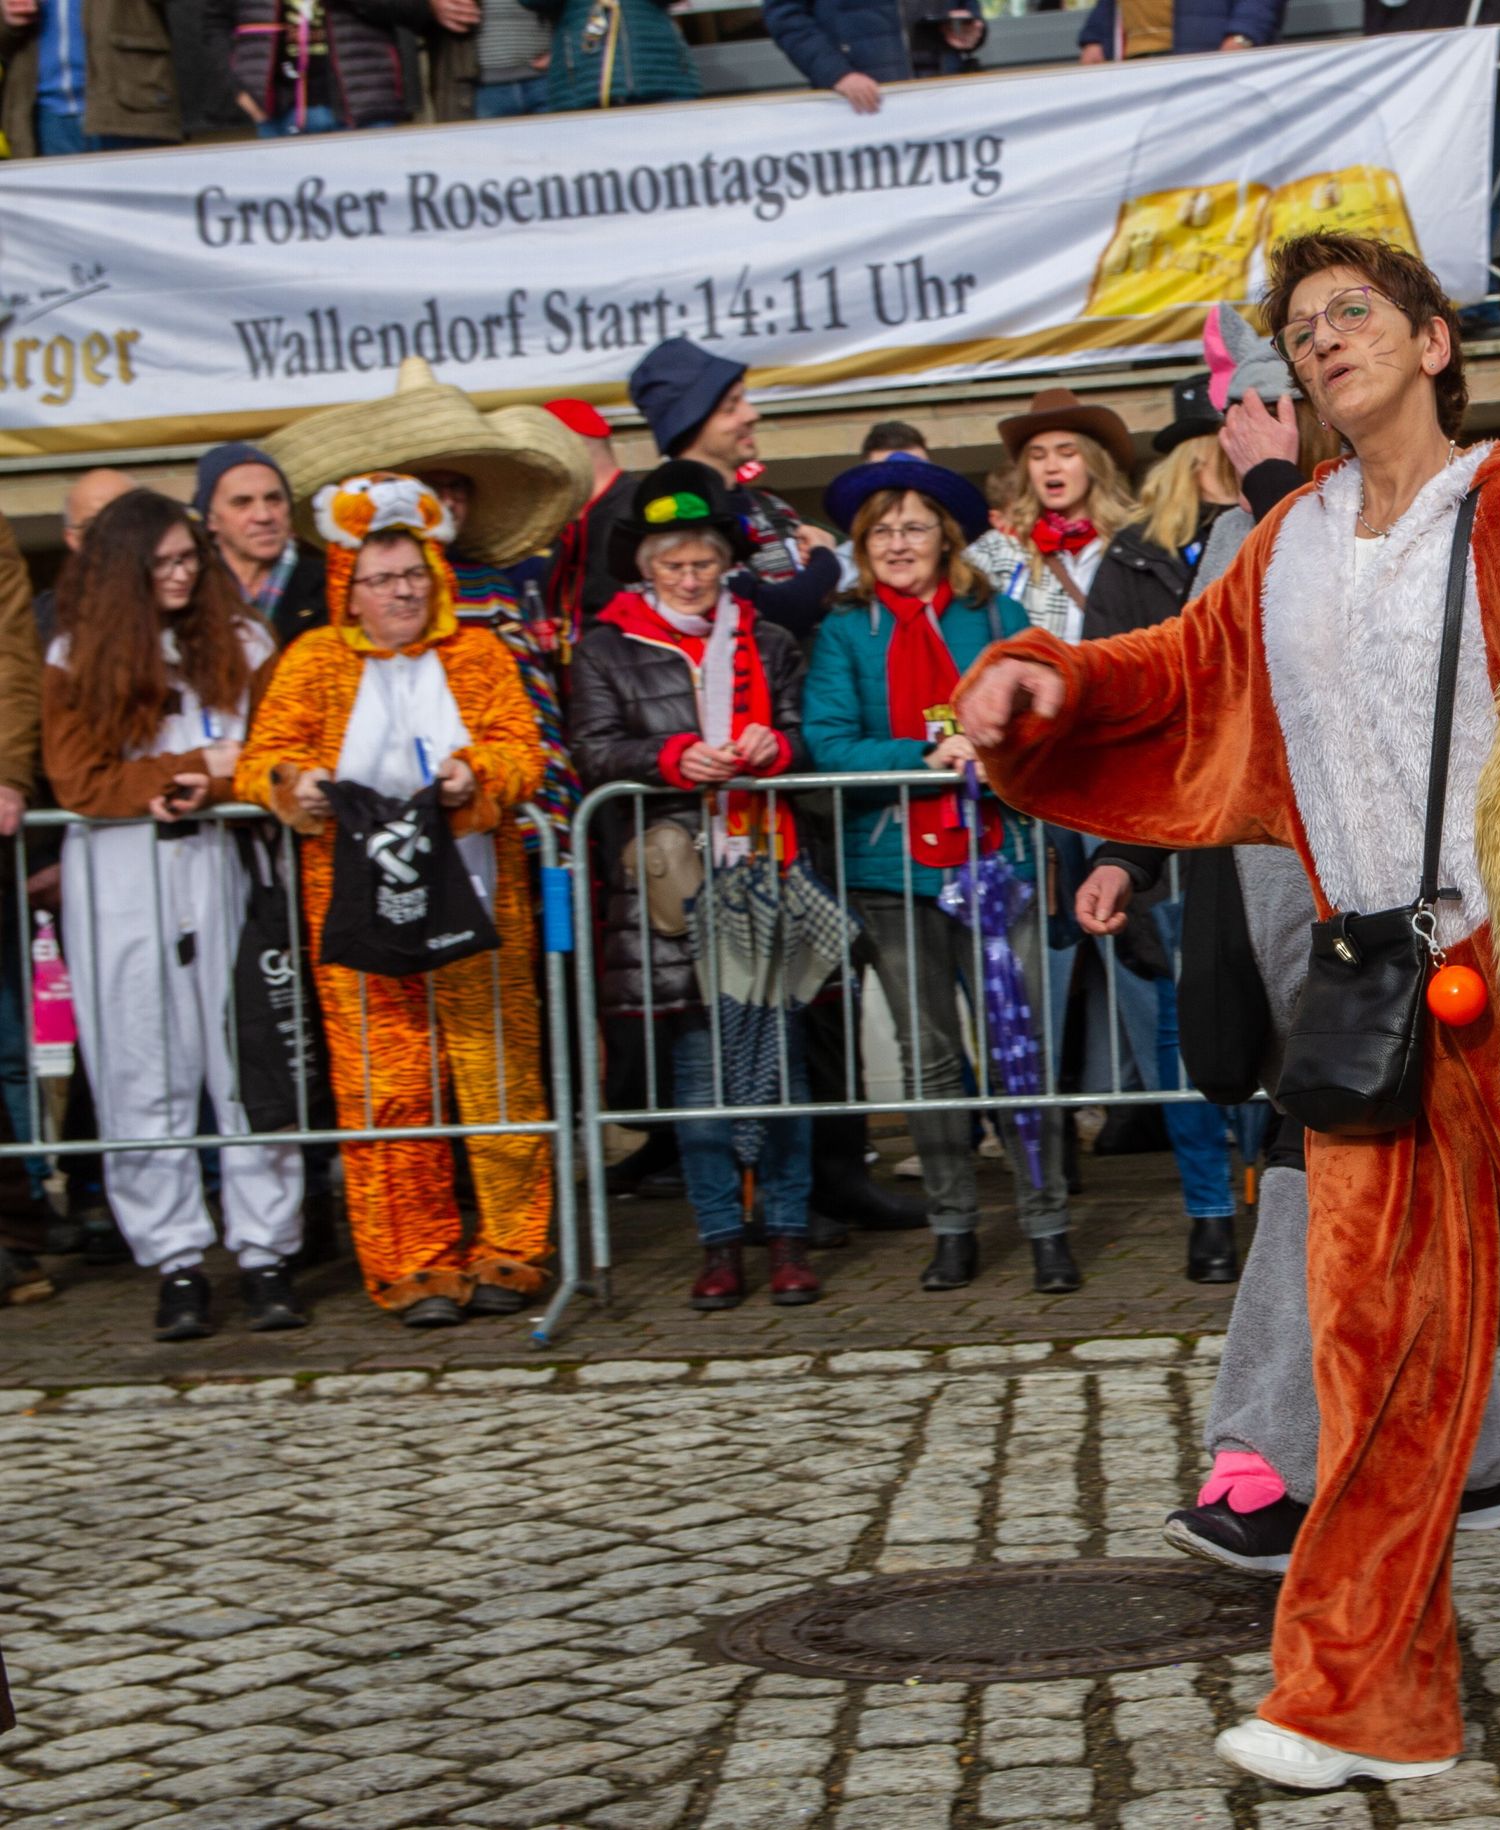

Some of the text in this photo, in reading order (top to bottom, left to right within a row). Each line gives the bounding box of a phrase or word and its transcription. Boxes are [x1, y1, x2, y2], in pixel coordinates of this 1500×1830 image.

[195, 134, 1004, 248] Großer Rosenmontagsumzug
[0, 328, 142, 407] rger
[232, 288, 529, 380] Wallendorf
[866, 254, 977, 327] Uhr
